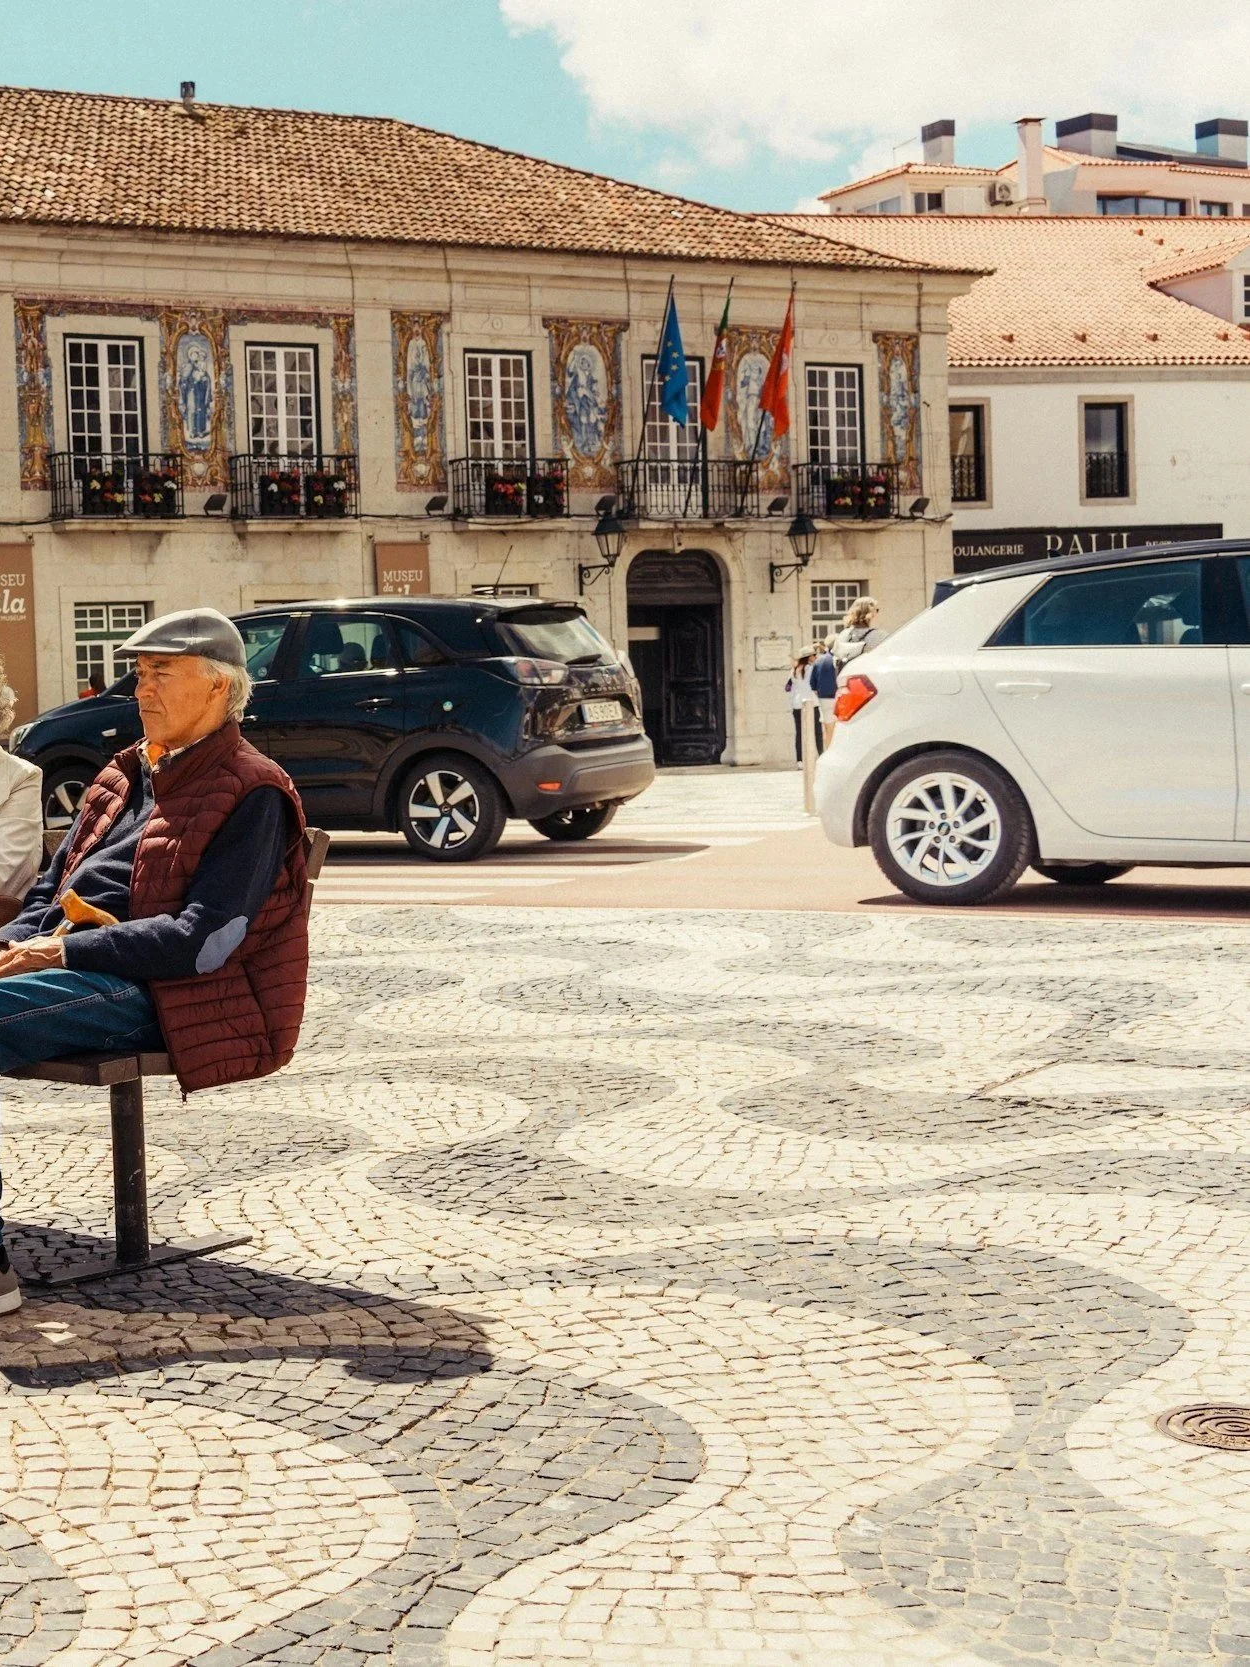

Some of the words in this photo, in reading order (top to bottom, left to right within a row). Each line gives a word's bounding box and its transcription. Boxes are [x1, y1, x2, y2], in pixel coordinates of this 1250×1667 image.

[953, 544, 1024, 557] OULANGERIE
[383, 569, 423, 582] MUSEU
[383, 582, 394, 592] da
[0, 614, 27, 622] MUSEUM
